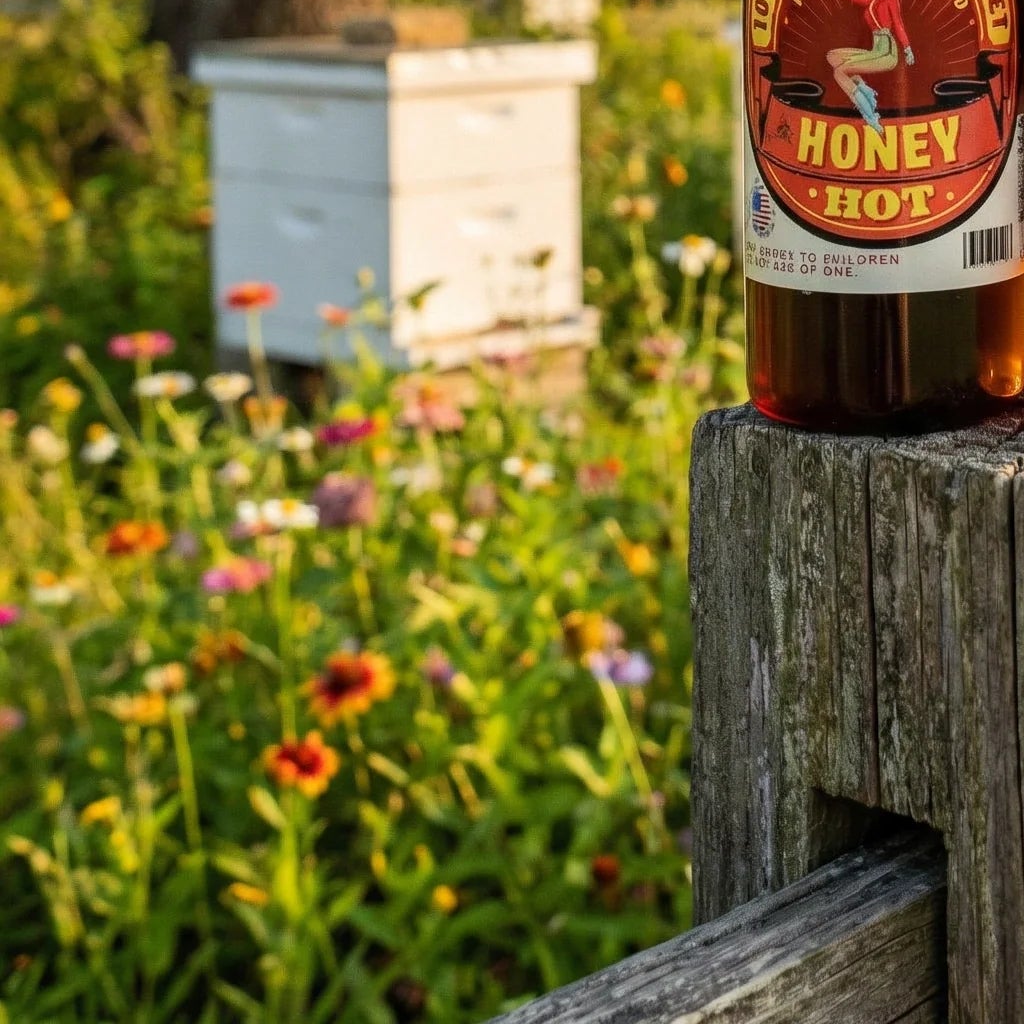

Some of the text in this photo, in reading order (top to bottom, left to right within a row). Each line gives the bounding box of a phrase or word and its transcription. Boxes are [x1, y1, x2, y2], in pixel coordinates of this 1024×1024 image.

[797, 115, 961, 172] HONEY
[823, 184, 936, 222] HOT
[800, 252, 817, 263] TO
[823, 265, 858, 277] ONE.
